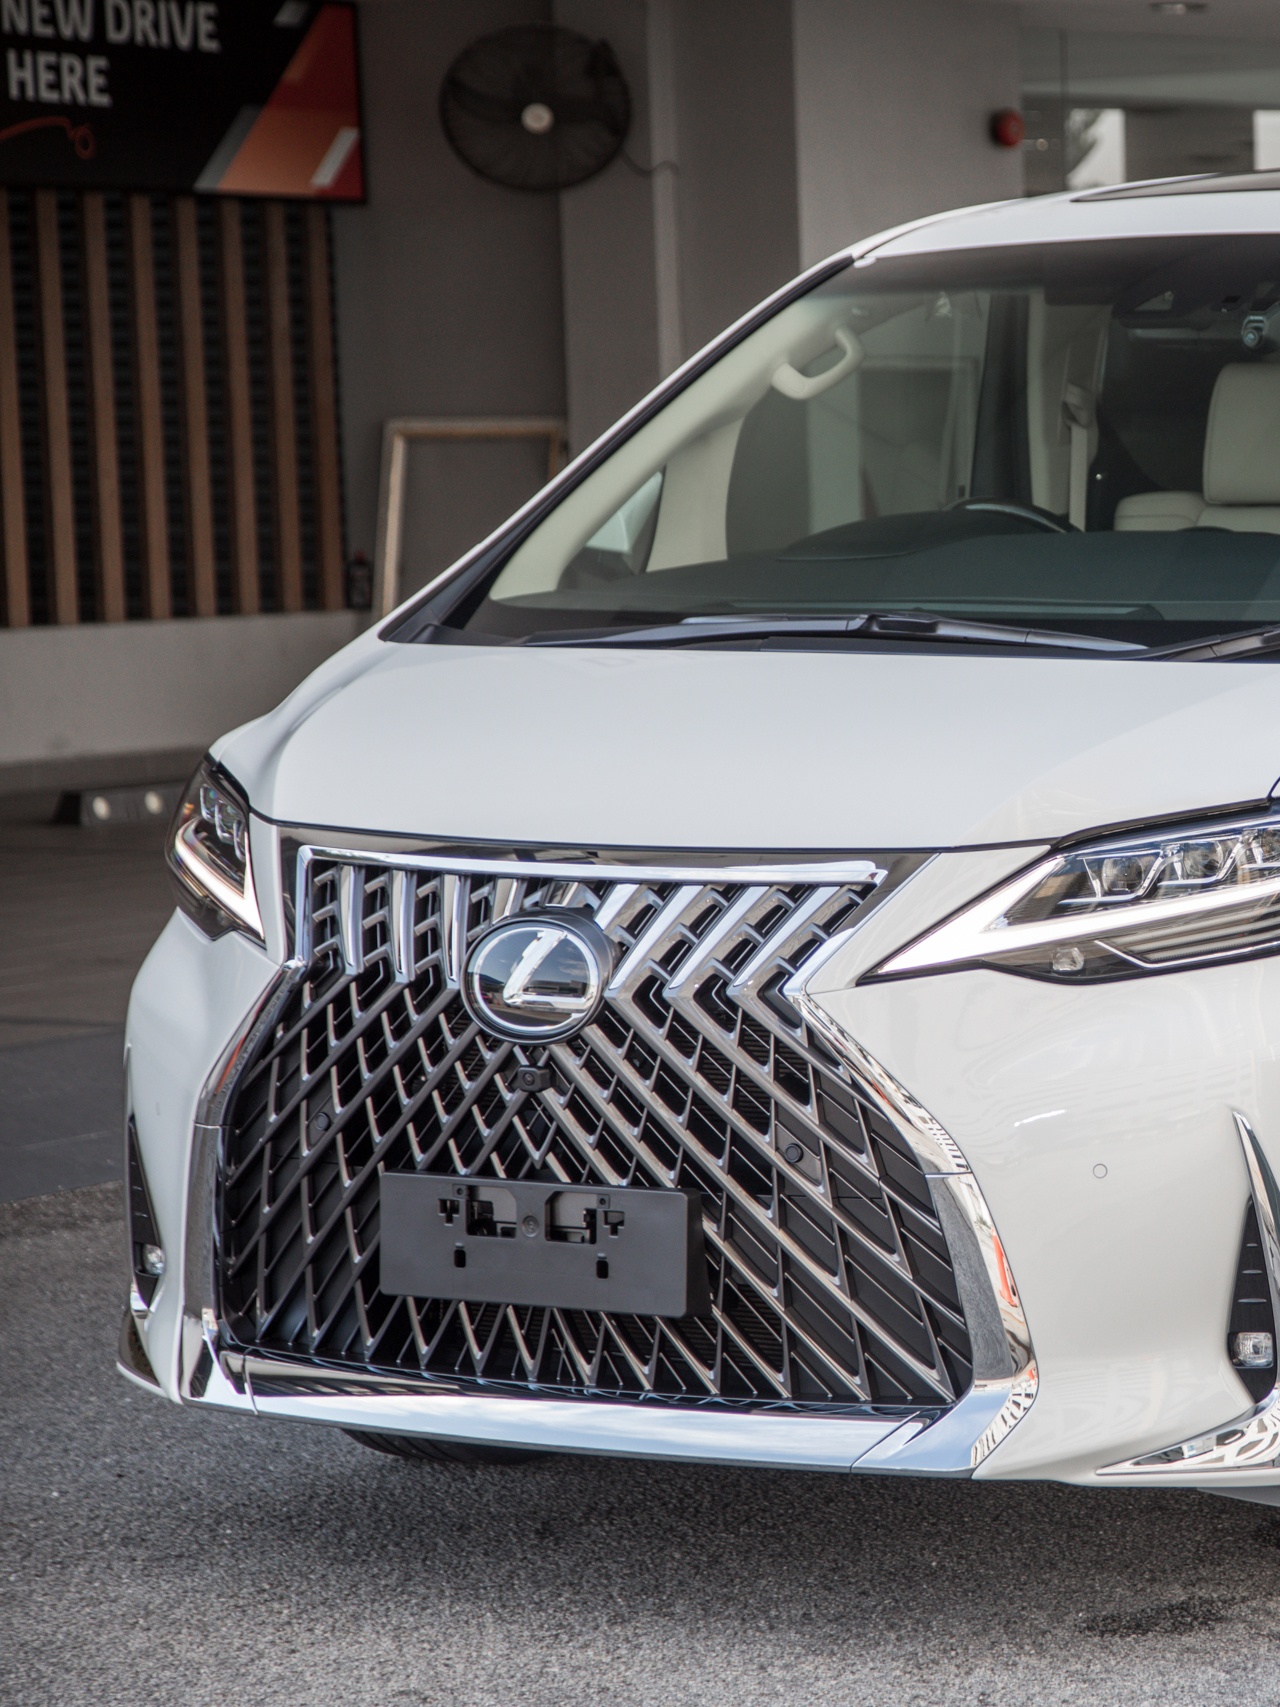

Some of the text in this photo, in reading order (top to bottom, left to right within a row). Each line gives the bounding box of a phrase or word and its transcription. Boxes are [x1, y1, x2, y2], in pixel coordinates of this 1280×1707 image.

[2, 0, 221, 52] NEW DRIVE
[7, 49, 112, 107] HERE
